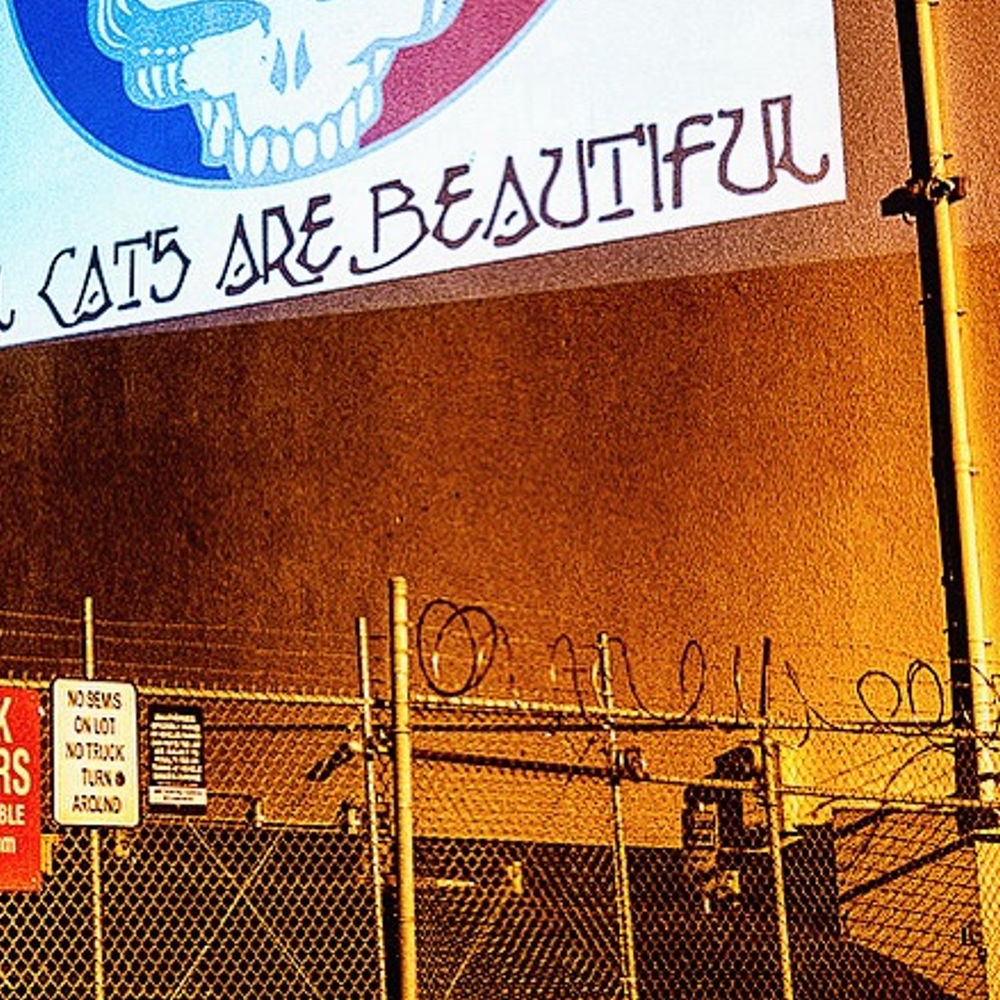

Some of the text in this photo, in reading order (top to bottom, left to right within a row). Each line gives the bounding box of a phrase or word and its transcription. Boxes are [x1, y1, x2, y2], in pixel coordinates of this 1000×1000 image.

[38, 226, 192, 329] CATS
[215, 193, 342, 297] ARE
[349, 94, 831, 275] BEAUTIFUL
[67, 690, 83, 708] NO
[74, 715, 116, 735] ON LOT
[65, 742, 126, 762] NO TRUCK
[81, 767, 112, 787] TURN
[72, 794, 123, 814] AROUND
